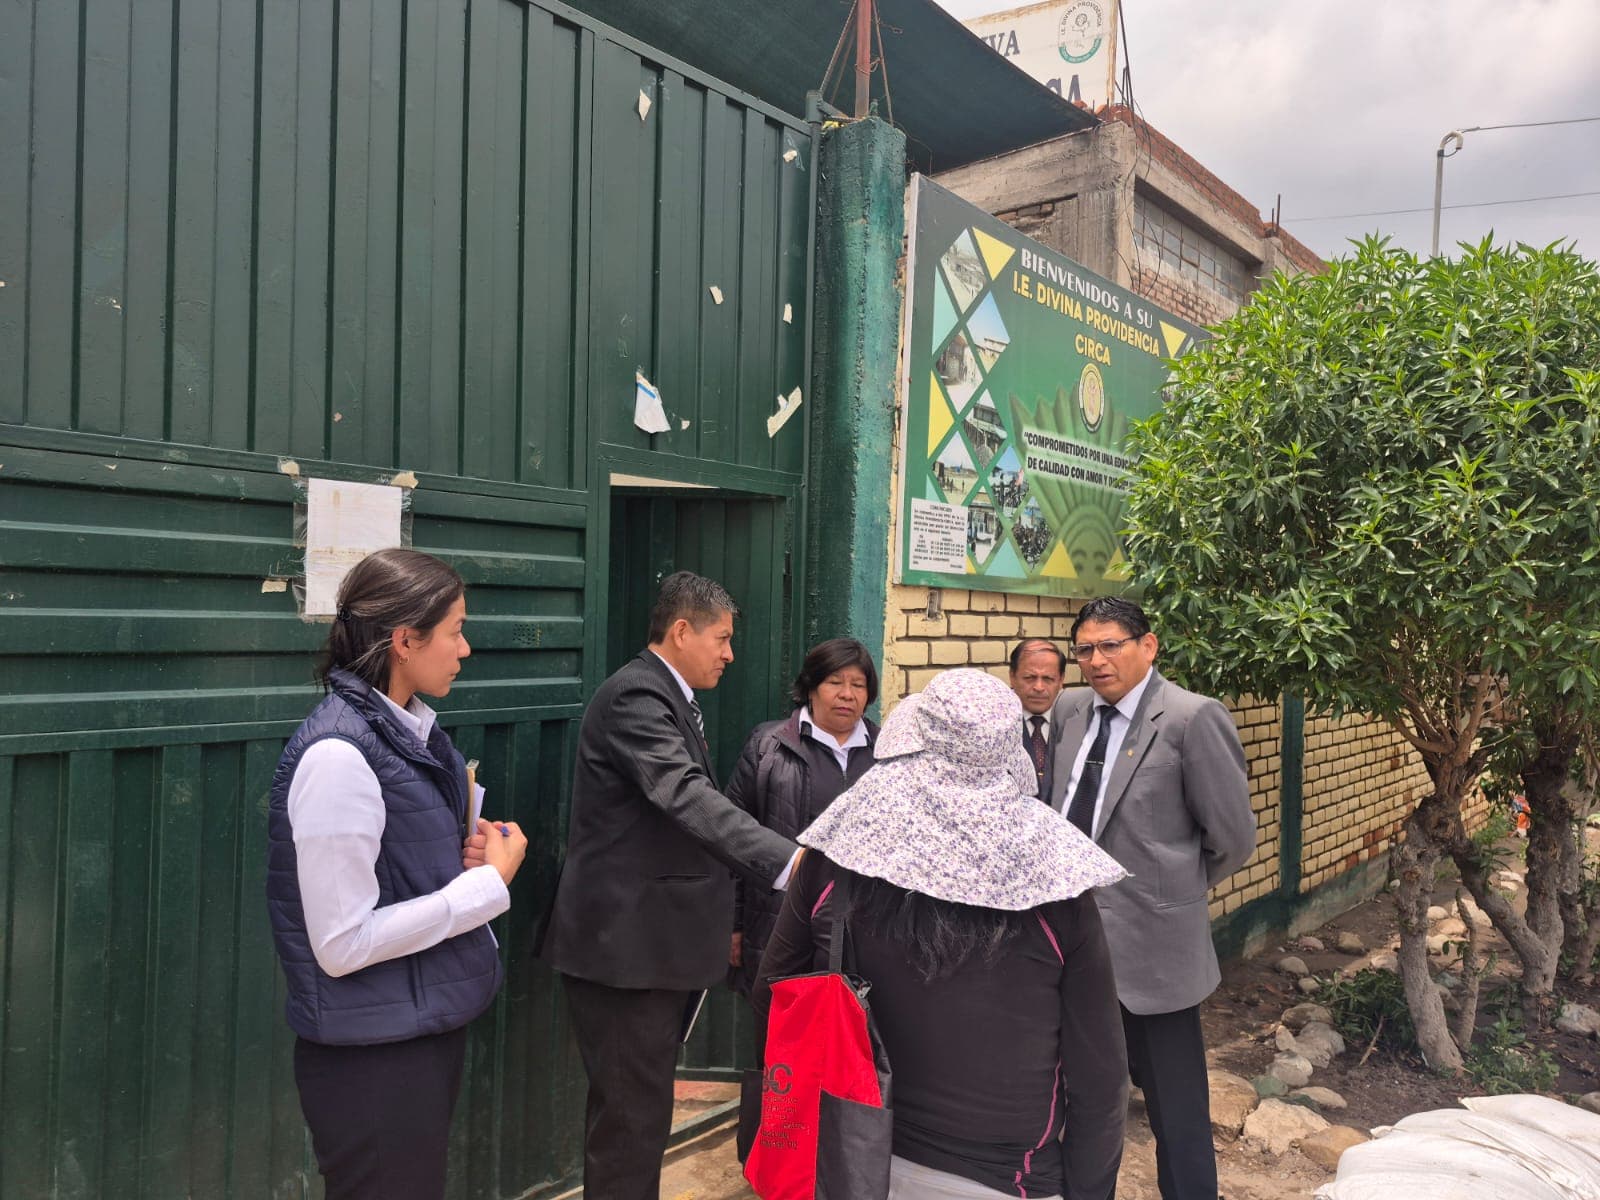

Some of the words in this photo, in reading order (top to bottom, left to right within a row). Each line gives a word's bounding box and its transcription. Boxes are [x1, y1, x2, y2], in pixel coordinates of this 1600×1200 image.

[1021, 248, 1120, 313] BIENVENIDOS
[1123, 302, 1133, 320] A
[1136, 308, 1153, 329] SU
[1013, 270, 1033, 300] I.E.
[1036, 281, 1083, 322] DIVINA
[1085, 305, 1160, 358] PROVIDENCIA
[1075, 334, 1111, 366] CIRCA
[1027, 456, 1037, 470] DE
[1038, 458, 1069, 477] CALIDAD
[1071, 466, 1084, 480] CON
[1086, 470, 1103, 485] AMOR
[1103, 474, 1108, 486] Y
[1089, 449, 1101, 463] POR
[1101, 452, 1113, 467] UNA
